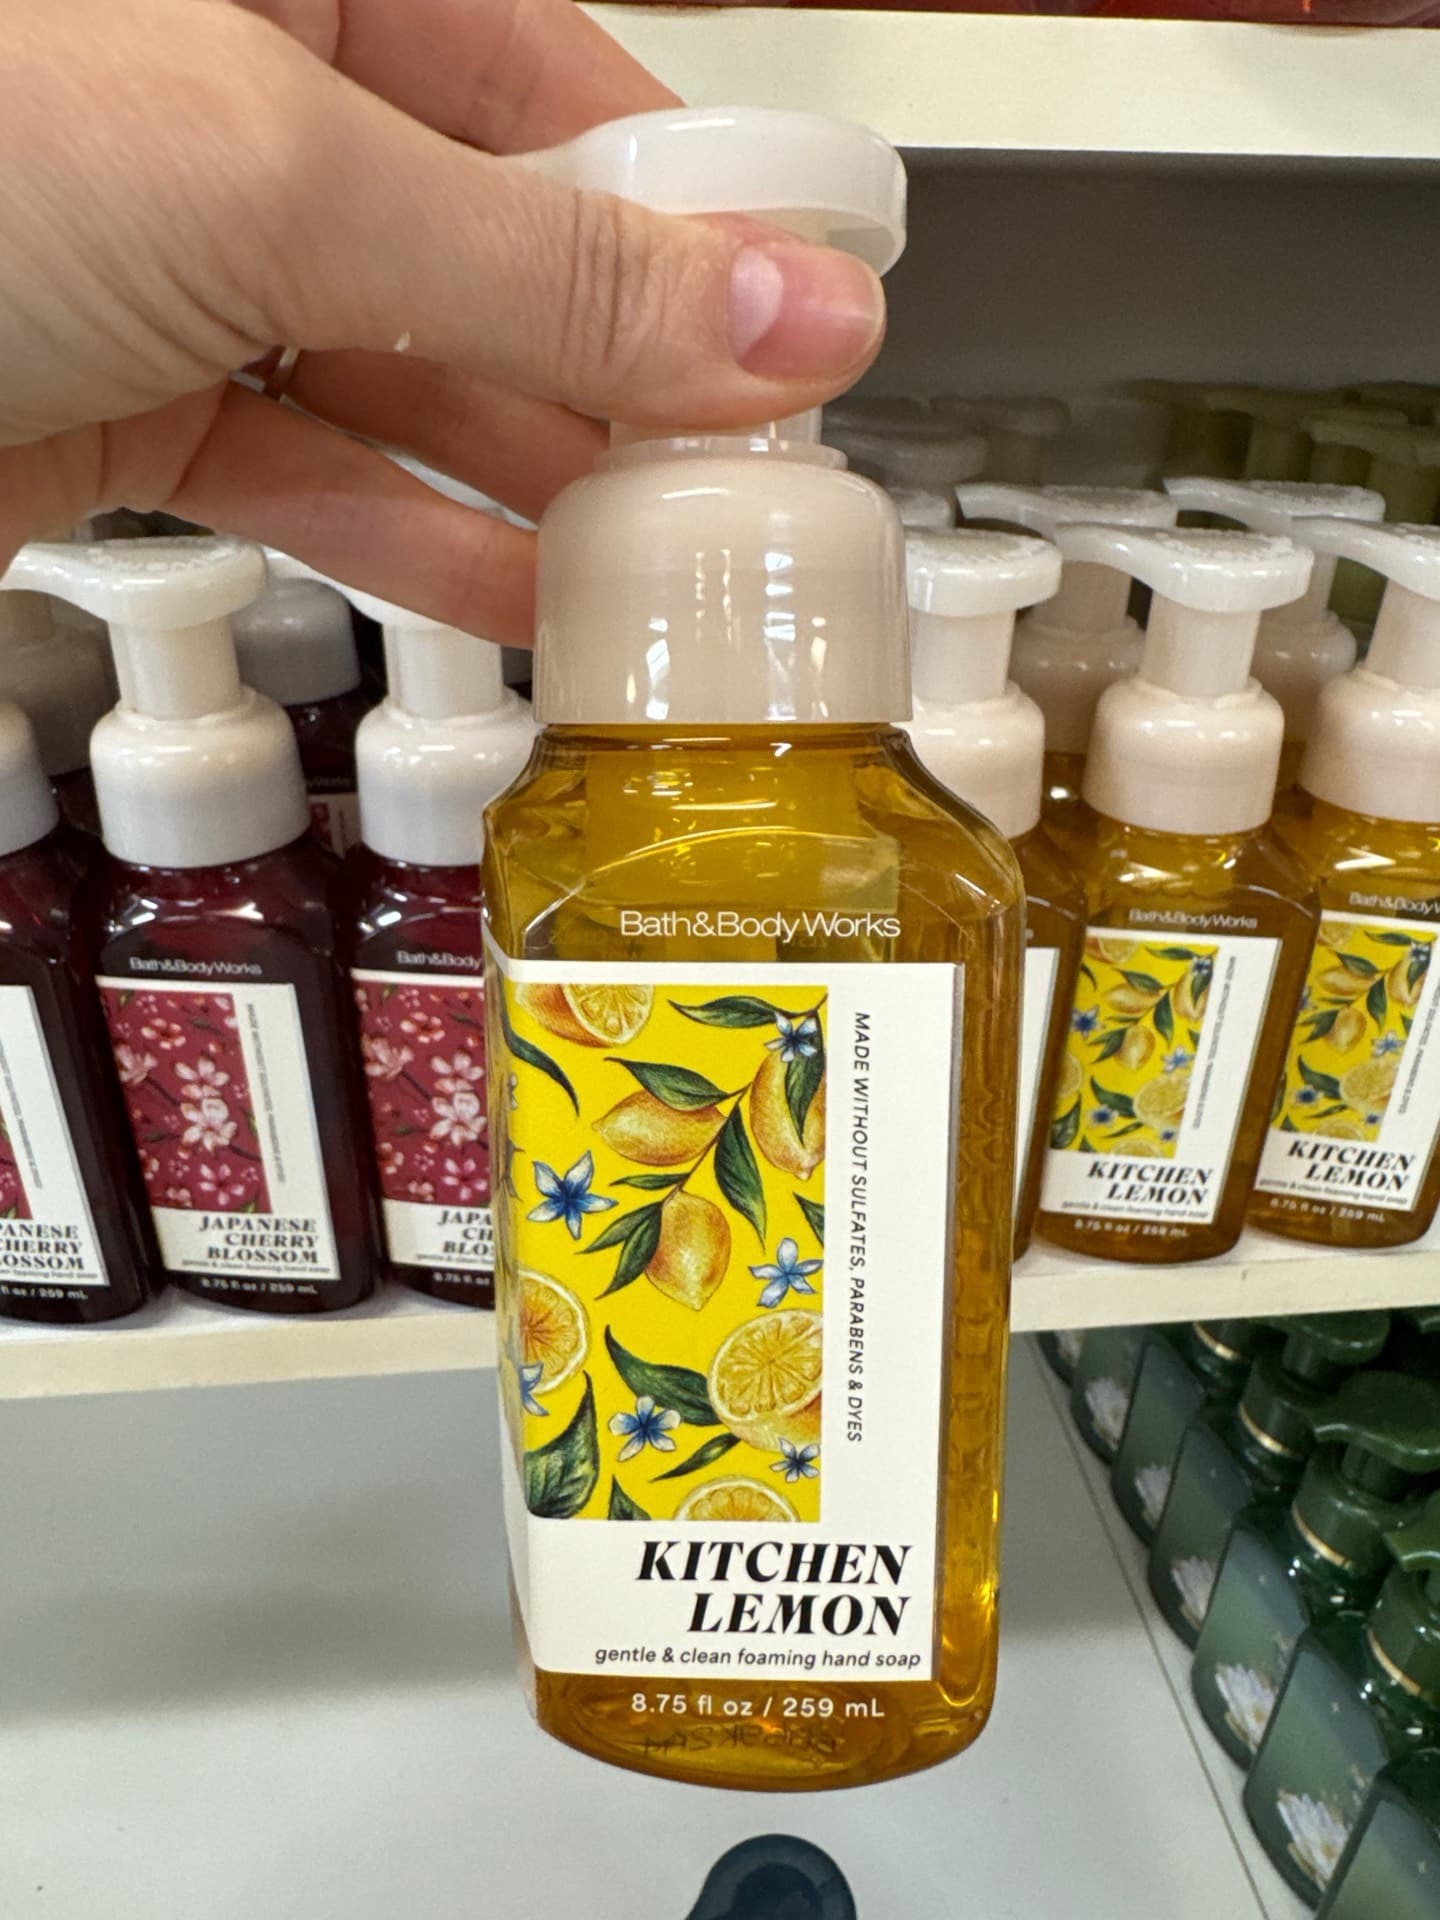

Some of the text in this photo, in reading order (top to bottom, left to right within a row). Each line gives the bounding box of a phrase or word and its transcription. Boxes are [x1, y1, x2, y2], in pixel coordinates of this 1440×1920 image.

[1287, 1140, 1416, 1171] KITCHEN
[1087, 1161, 1213, 1185] KITCHEN
[1305, 1163, 1410, 1192] LEMON
[1107, 1183, 1209, 1206] LEMON
[0, 1223, 79, 1240] ANESE
[199, 1215, 317, 1233] JAPANESE
[847, 1012, 870, 1442] MADE WITHOUT SULFATES, PARABENS & DYES
[225, 1233, 319, 1248] CHERRY
[0, 1254, 85, 1270] OSSOM
[207, 1247, 319, 1264] BLOSSOM
[635, 1541, 912, 1585] KITCHEN
[687, 1593, 911, 1636] LEMON
[595, 1646, 921, 1670] gentle & clean foaming hand soap
[632, 1693, 885, 1719] 8.75 fl oz / 259 mL
